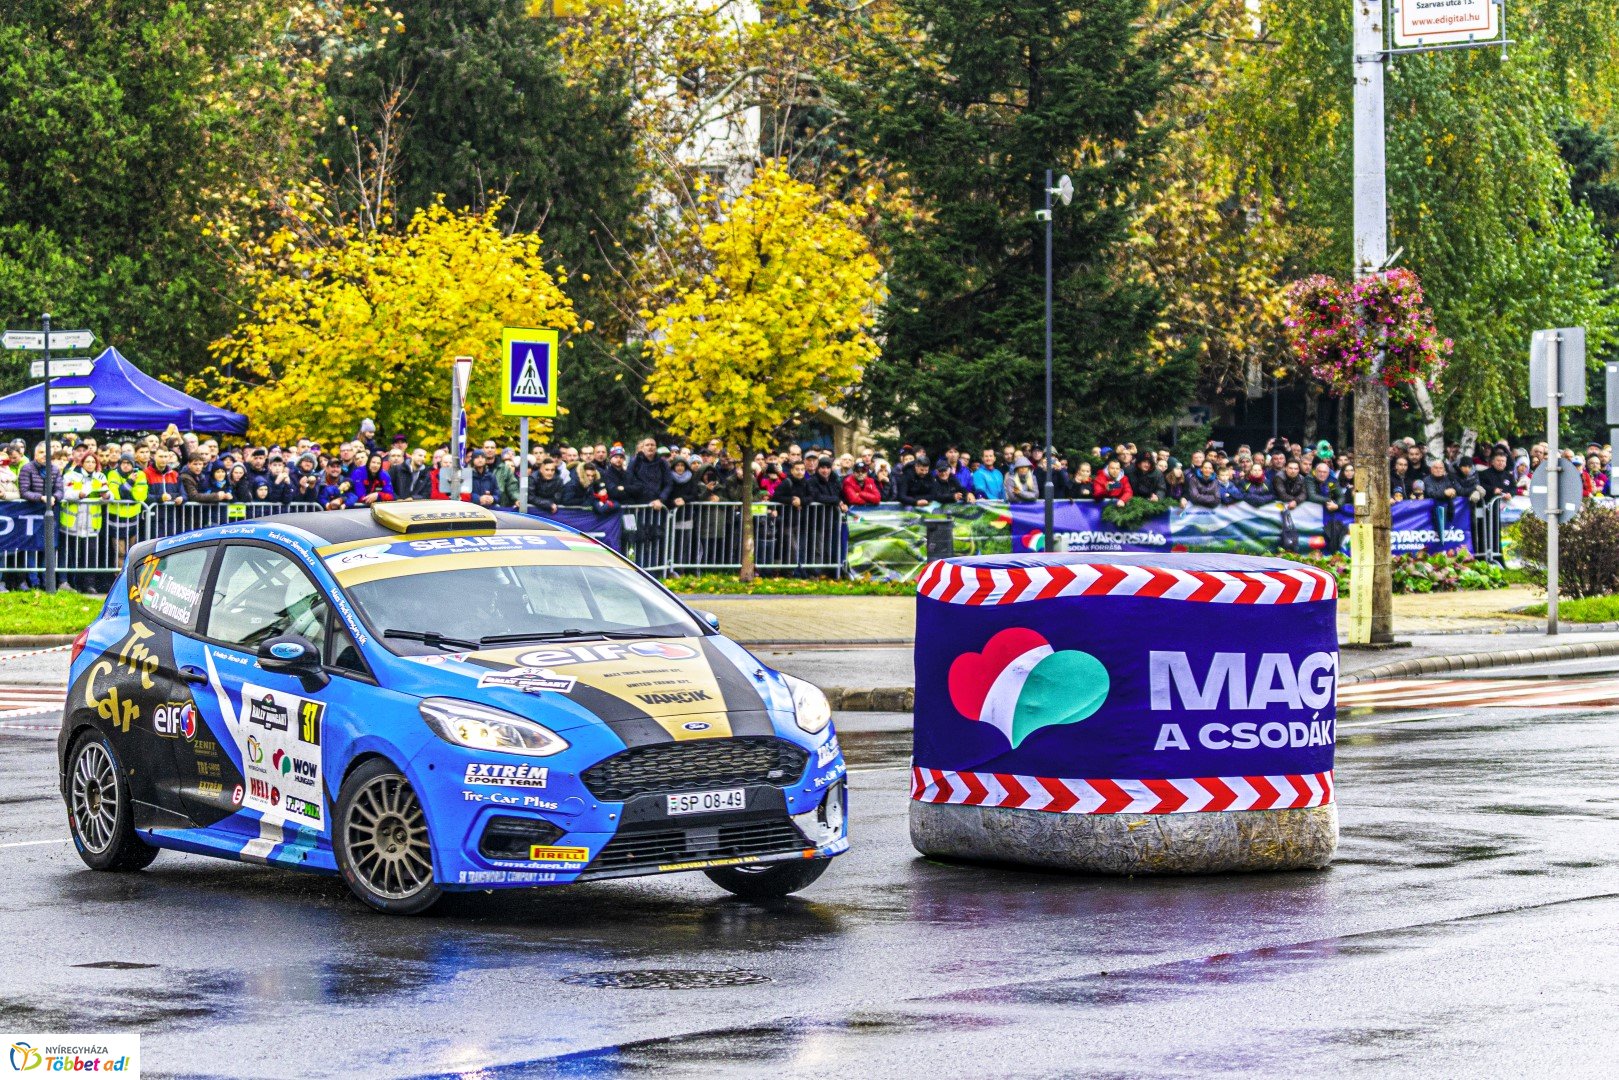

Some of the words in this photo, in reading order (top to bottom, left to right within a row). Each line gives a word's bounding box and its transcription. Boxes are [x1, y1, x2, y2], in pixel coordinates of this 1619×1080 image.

[1416, 1, 1445, 9] Szarvas
[1411, 13, 1480, 26] www.edigital.hu
[409, 535, 547, 551] SEAJETS
[150, 592, 159, 609] D.
[158, 596, 191, 624] Pannuska
[517, 643, 627, 667] elf
[1149, 650, 1338, 711] MAG
[85, 661, 140, 733] Car
[154, 706, 181, 734] elf
[302, 702, 319, 744] 37
[1154, 723, 1191, 750] A
[1198, 711, 1332, 750] CSODÁK
[293, 758, 318, 778] WOW
[466, 763, 549, 780] EXTRÉM
[250, 777, 270, 801] HELL
[467, 776, 506, 785] SPORT
[509, 778, 544, 787] TEAM
[462, 791, 519, 805] Tre-Car
[523, 796, 558, 810] Plus
[680, 796, 699, 811] SP
[703, 791, 742, 809] 08-49
[534, 847, 585, 860] PIRELLI
